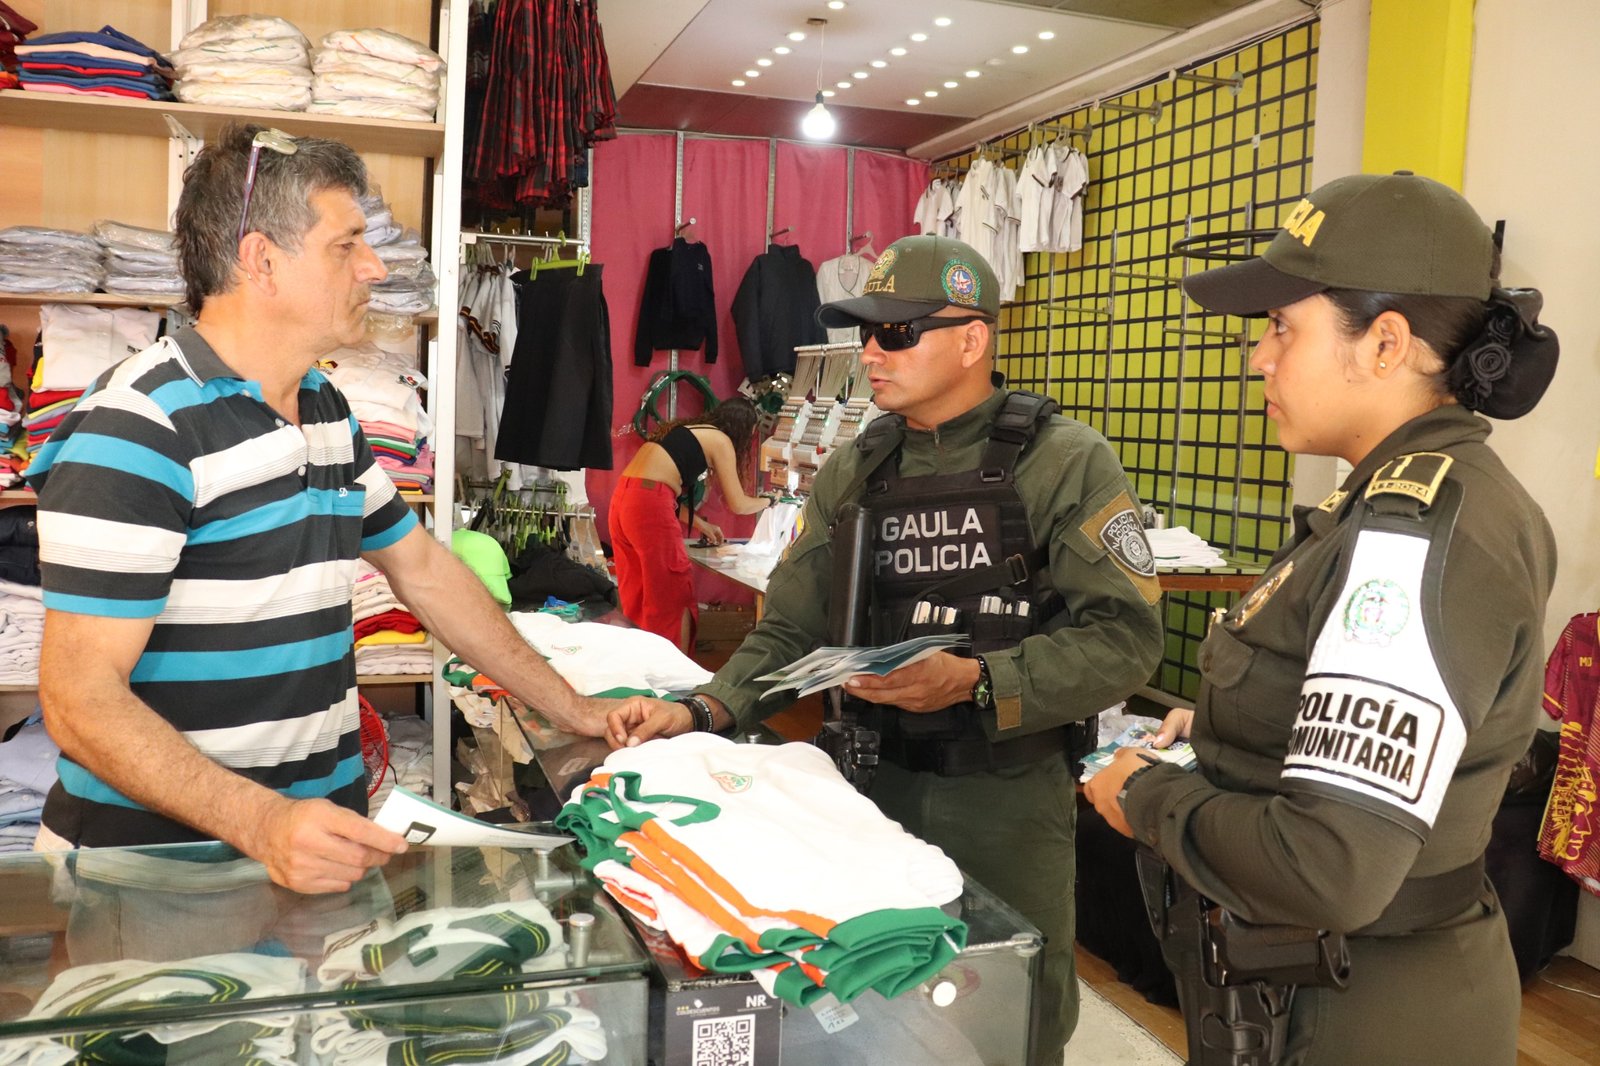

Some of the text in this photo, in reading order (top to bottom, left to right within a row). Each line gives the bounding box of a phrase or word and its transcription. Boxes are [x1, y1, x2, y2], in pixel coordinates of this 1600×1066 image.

[881, 508, 984, 542] GAULA
[1111, 522, 1142, 551] NACIONAL
[874, 542, 993, 576] POLICIA
[746, 995, 766, 1008] NR
